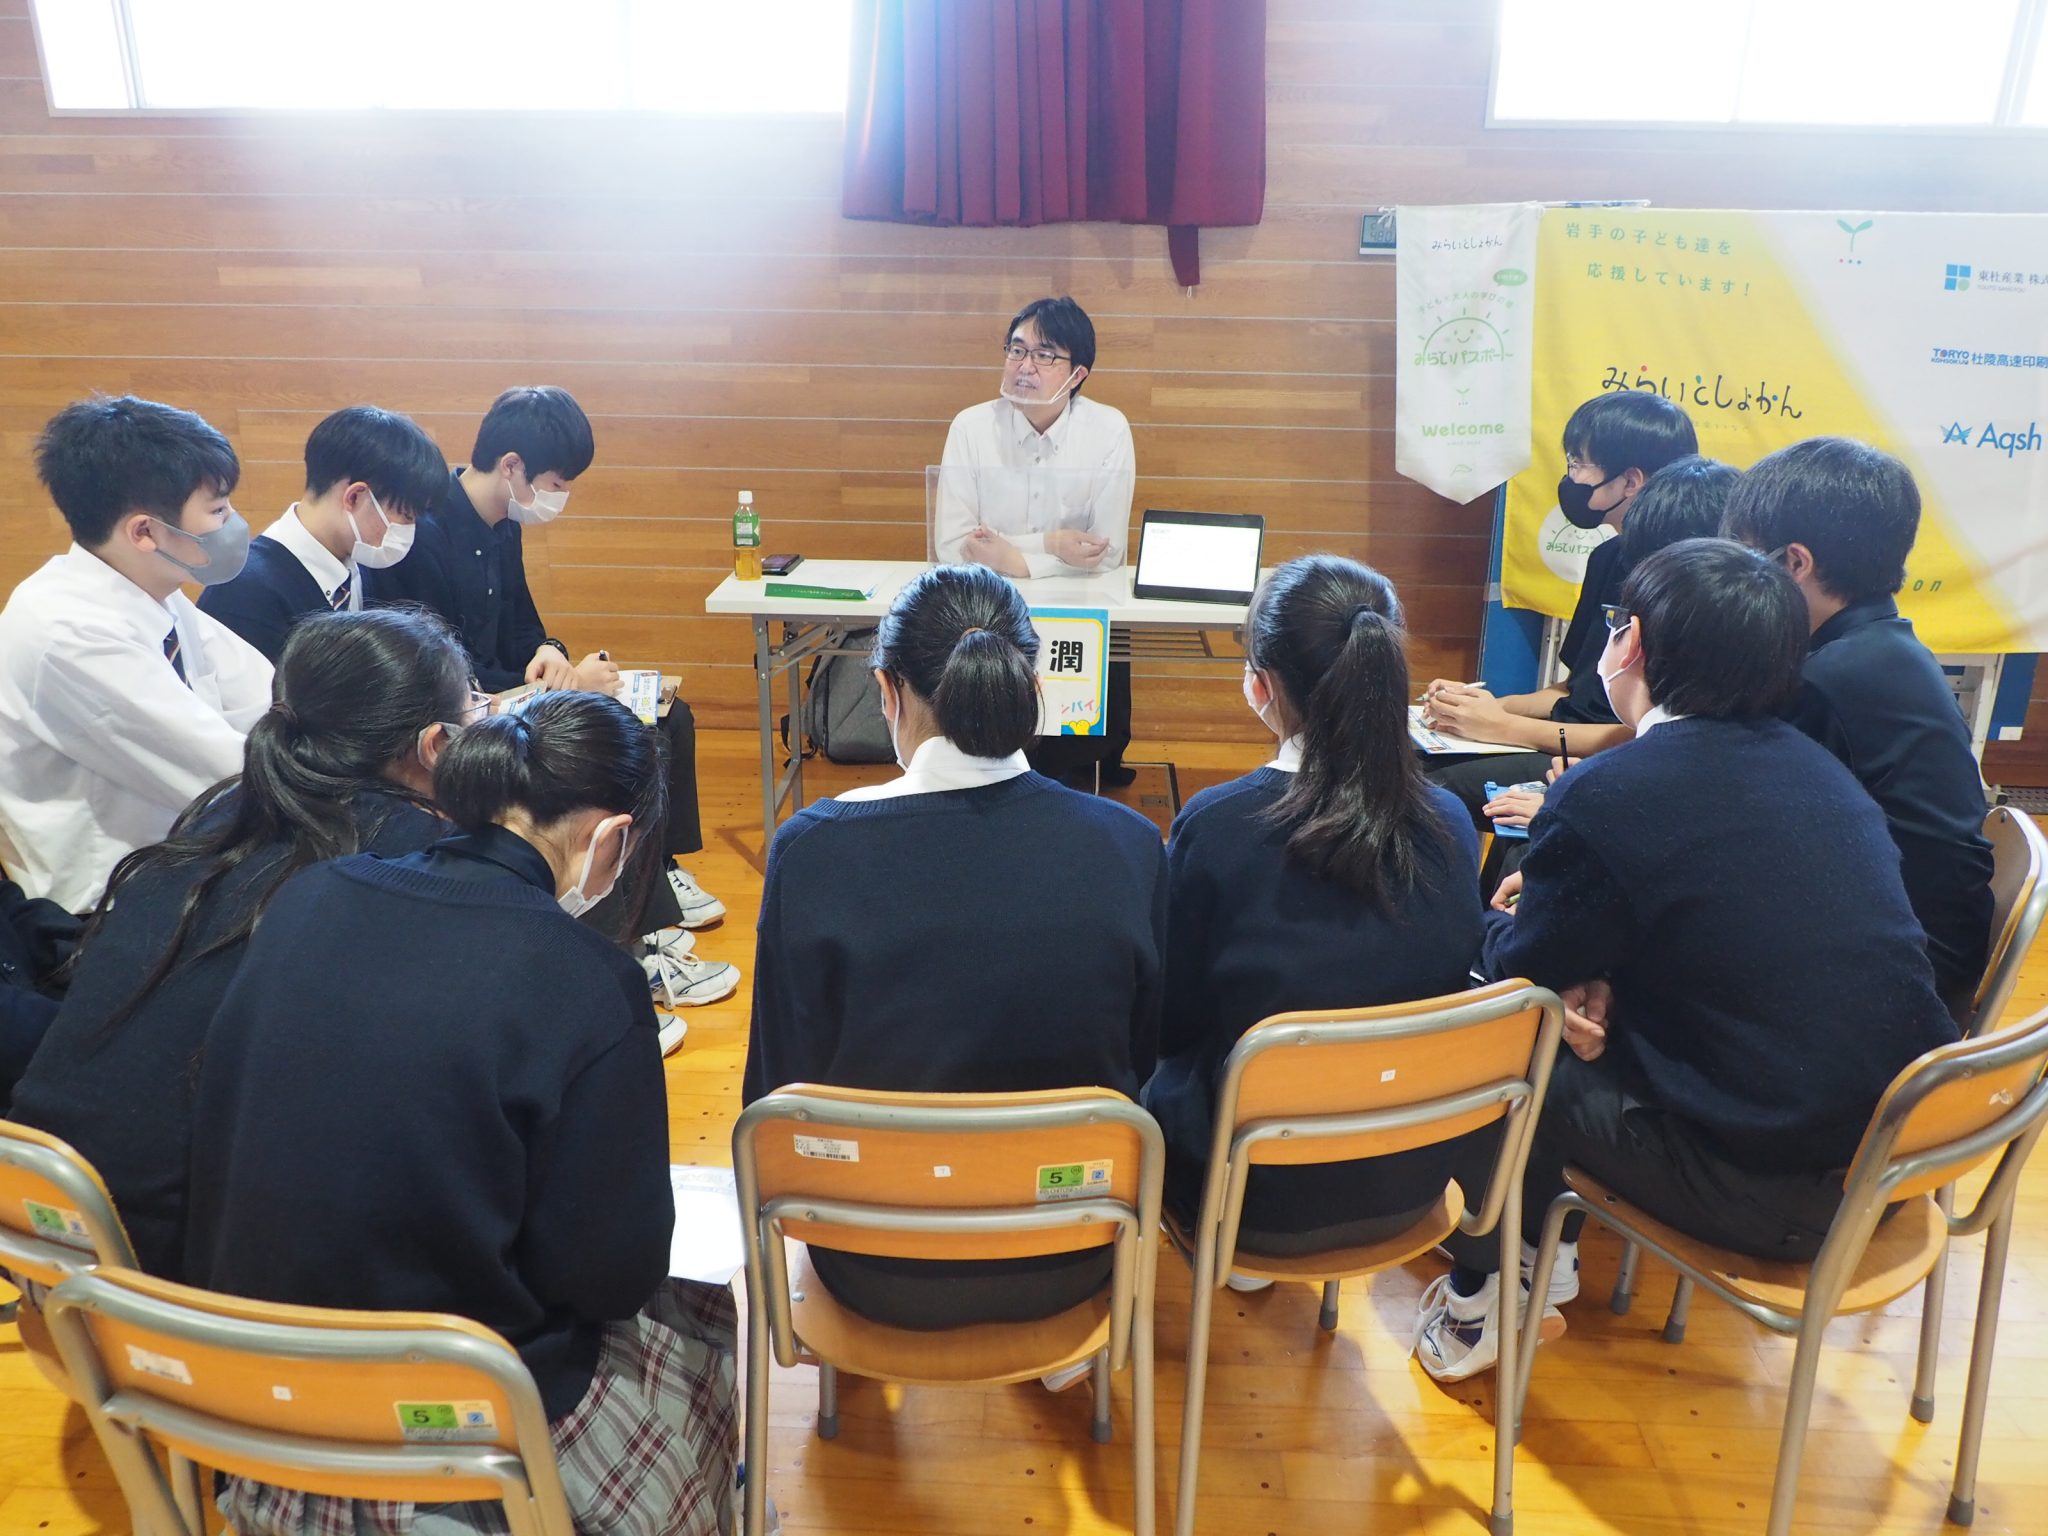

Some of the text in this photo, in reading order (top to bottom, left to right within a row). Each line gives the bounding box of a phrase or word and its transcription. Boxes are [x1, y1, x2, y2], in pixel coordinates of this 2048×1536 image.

[1431, 236, 1503, 250] みらいとしょかん
[1566, 222, 1732, 255] 岩手の子ども達を
[1602, 365, 1802, 418] みらいとしょかん
[1422, 423, 1505, 437] Welcome
[1976, 422, 2042, 459] Aqsh
[1049, 640, 1084, 673] 潤
[1050, 1171, 1063, 1185] 5
[413, 1409, 430, 1424] 5
